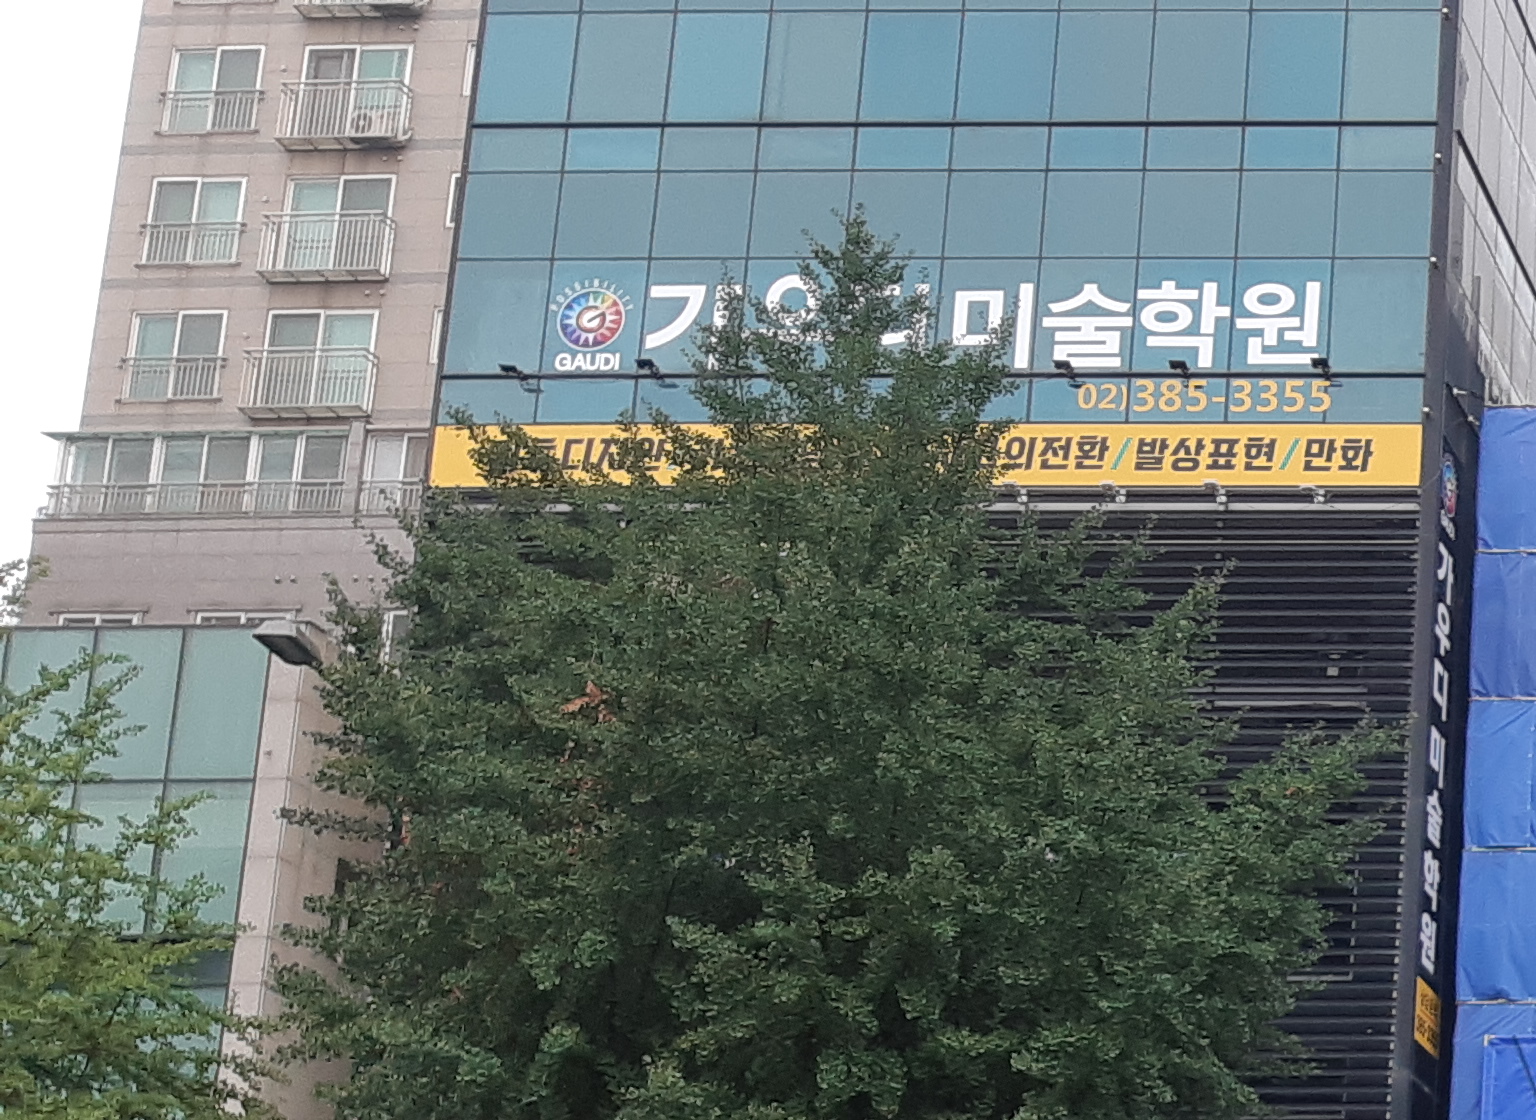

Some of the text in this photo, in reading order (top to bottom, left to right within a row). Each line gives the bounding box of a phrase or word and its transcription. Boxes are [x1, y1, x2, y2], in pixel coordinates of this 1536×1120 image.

[554, 352, 620, 371] GAUDI
[1077, 379, 1332, 412] 02)385-3355
[1302, 437, 1374, 472] 만화
